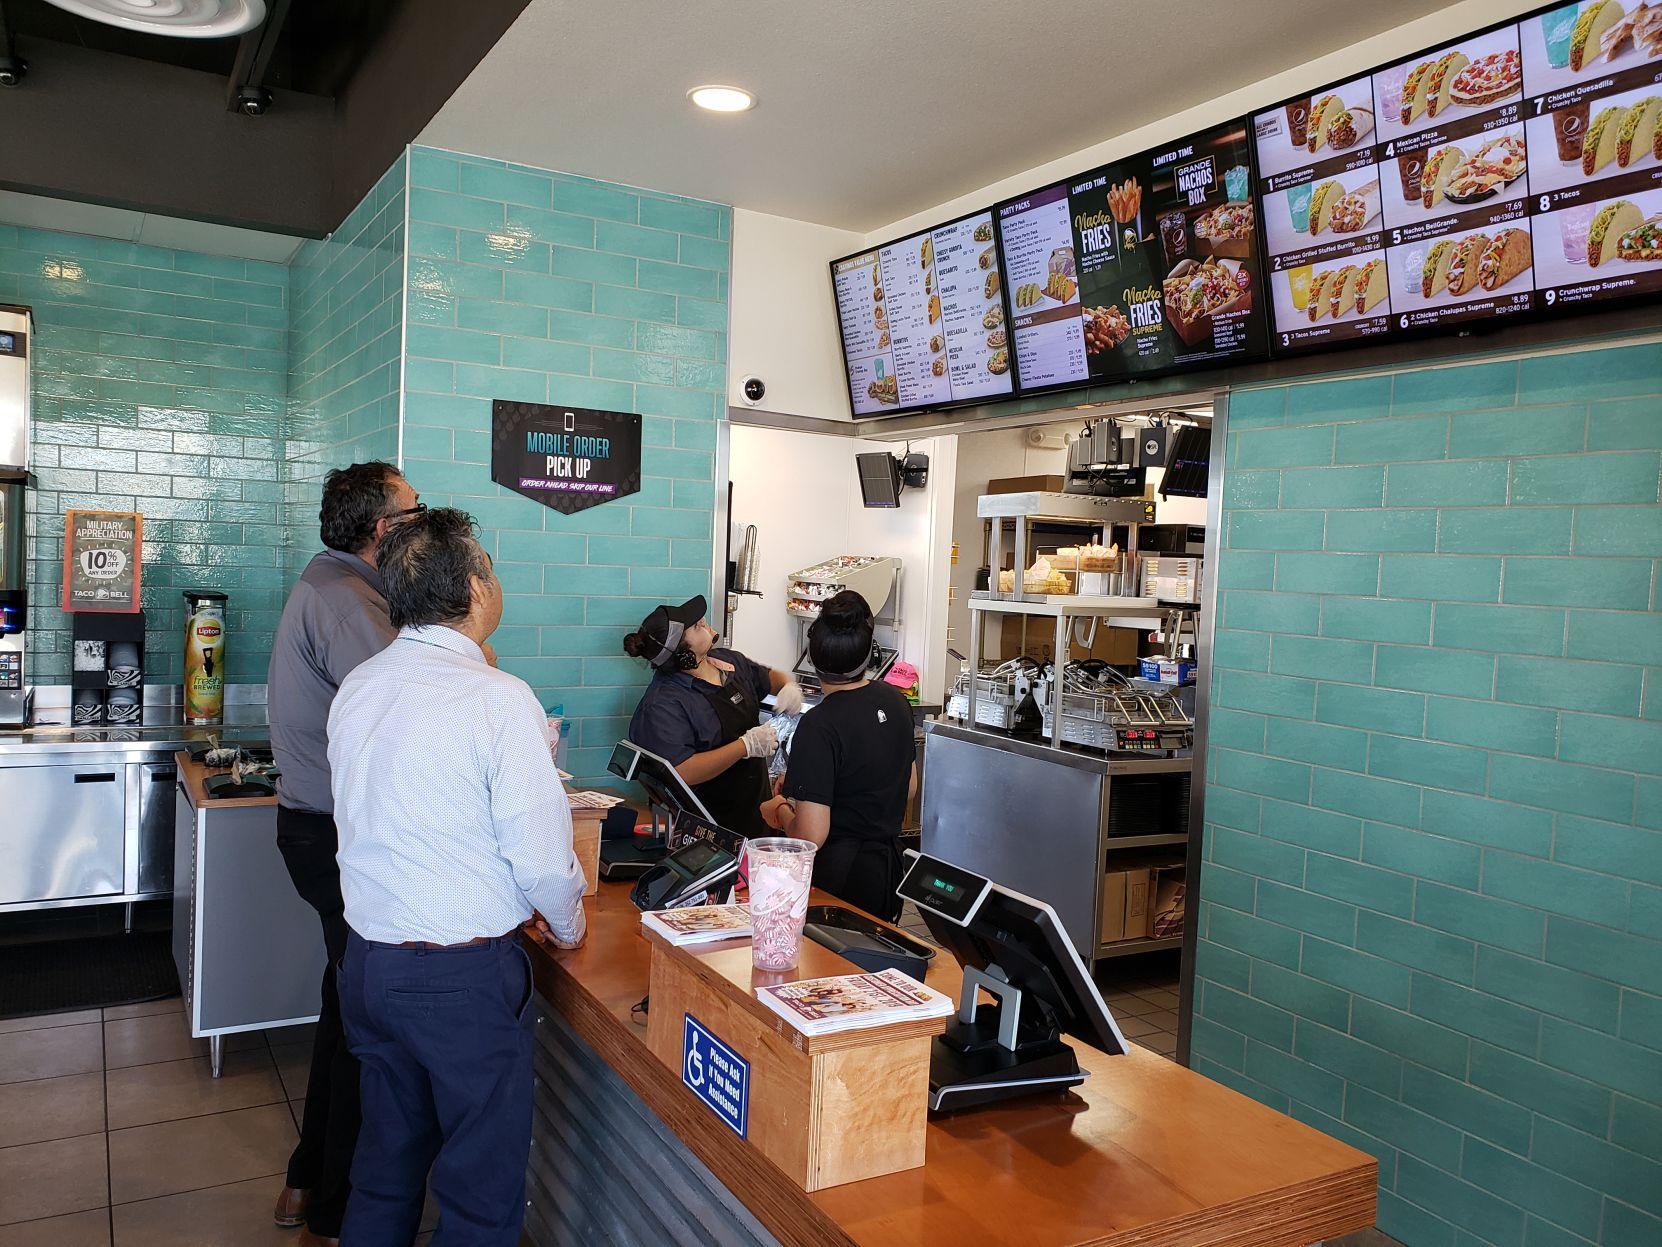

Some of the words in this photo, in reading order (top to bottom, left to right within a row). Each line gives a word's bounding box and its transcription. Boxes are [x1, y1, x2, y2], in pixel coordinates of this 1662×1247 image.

[1534, 97, 1545, 115] 7
[1548, 90, 1575, 104] Chicken
[1577, 80, 1614, 95] Quesadilla
[1385, 143, 1395, 158] 4
[1397, 137, 1421, 148] Mexican
[1422, 131, 1438, 142] Pizza
[1153, 152, 1177, 167] LIMITED
[1178, 146, 1194, 159] TIME
[1178, 159, 1212, 176] GRANDE
[1072, 182, 1093, 195] LIMITED
[1094, 176, 1107, 188] TIME
[1179, 168, 1213, 192] NACHOS
[1268, 178, 1274, 192] 1
[1275, 173, 1292, 184] Burrito
[1188, 186, 1207, 206] BOX
[1540, 195, 1551, 212] 8
[1561, 190, 1581, 200] Tacos
[1000, 205, 1015, 217] PARTY
[1015, 200, 1031, 213] PACKS
[1075, 210, 1112, 232] Nacho
[1081, 224, 1112, 254] FRIES
[1392, 230, 1402, 244] 5
[1404, 225, 1425, 235] Nachos
[1274, 257, 1282, 270] 2
[1283, 254, 1302, 262] Chicken
[1337, 242, 1356, 251] Burrito
[1123, 285, 1163, 307] Nacho
[1545, 290, 1556, 306] 9
[1559, 285, 1601, 297] Crunchwrap
[1602, 279, 1635, 292] Supreme
[1130, 299, 1163, 329] FRIES
[1400, 315, 1409, 329] 6
[1416, 310, 1439, 320] Chicken
[1440, 306, 1467, 317] Chalupas
[1468, 302, 1495, 313] Supreme
[1132, 323, 1163, 337] SUPREME
[1282, 334, 1290, 347] 3
[1309, 328, 1331, 337] Supreme
[527, 431, 570, 456] MOBILE
[573, 436, 611, 459] ORDER
[546, 456, 573, 479] PICK
[576, 458, 592, 479] UP
[521, 480, 545, 489] ORDER
[569, 483, 586, 491] SKIP
[599, 485, 614, 493] LINE
[76, 528, 133, 540] APPRECIATION
[86, 521, 124, 530] MILITARY
[198, 628, 220, 636] Lipton
[194, 675, 222, 686] fresh
[710, 1047, 729, 1074] Please
[729, 1063, 741, 1084] Ask
[709, 1064, 714, 1079] If
[714, 1068, 724, 1089] You
[725, 1078, 740, 1102] Need
[709, 1082, 739, 1120] Assistance
